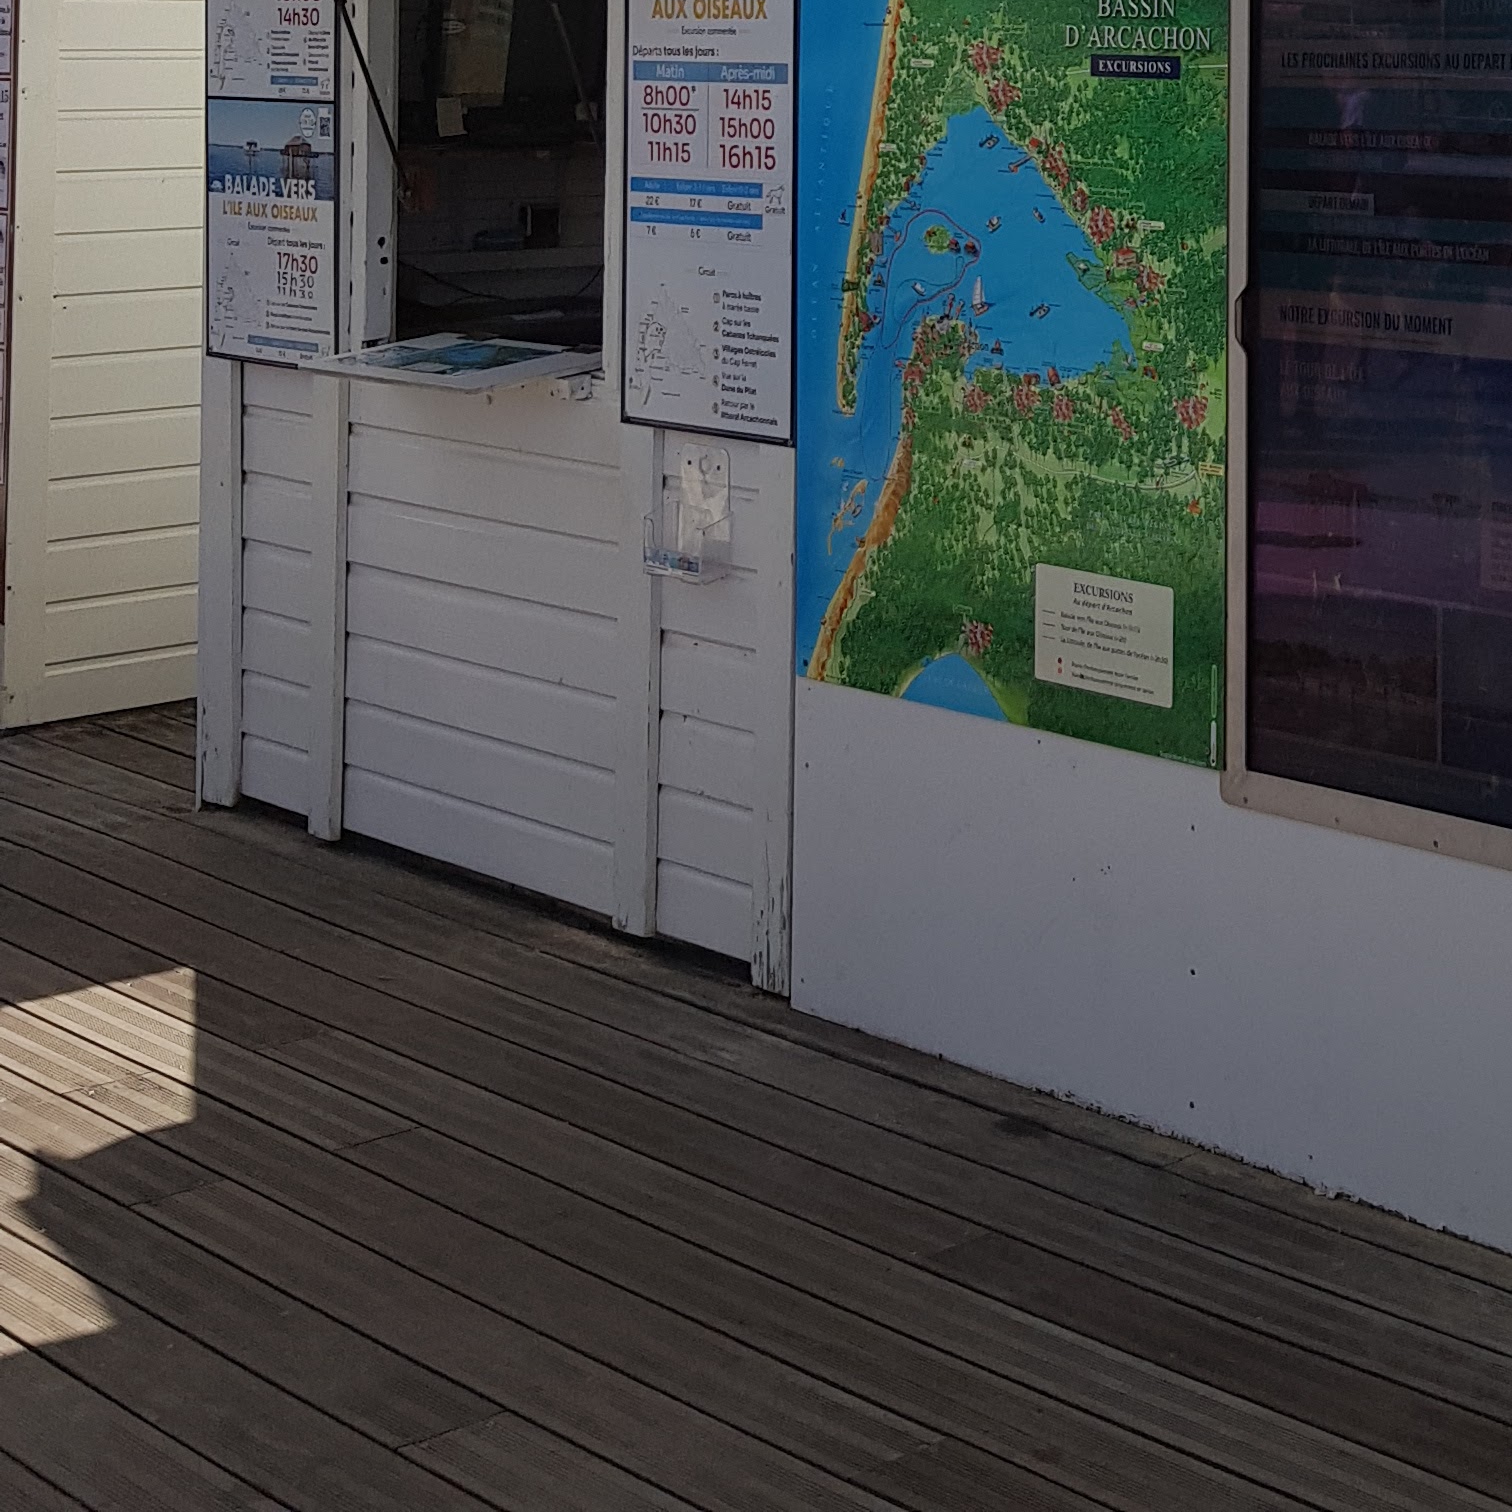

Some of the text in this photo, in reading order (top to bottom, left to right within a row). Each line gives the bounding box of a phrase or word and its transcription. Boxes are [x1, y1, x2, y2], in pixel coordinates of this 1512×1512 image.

[277, 7, 320, 26] 14h30
[1064, 24, 1212, 51] D'ARCACHON
[1098, 58, 1172, 74] EXCURSIONS
[1280, 50, 1299, 69] LES
[1301, 49, 1370, 70] PROCHAINES
[1371, 50, 1442, 71] EXCURSIONS
[1444, 52, 1461, 70] AU
[656, 62, 776, 83] Matin Après-midi
[723, 88, 773, 111] 14h15
[642, 112, 697, 136] 10h30
[719, 116, 776, 140] 15h00
[647, 140, 692, 164] 11h15
[719, 143, 778, 171] 16h15
[224, 174, 317, 201] BALADE VERS
[246, 201, 268, 219] AUX
[271, 203, 319, 223] OISEAUX
[277, 251, 319, 275] 17h30
[1278, 305, 1454, 336] NOTRE EXCURSION DU MOMENT
[1072, 581, 1134, 604] EXCURSIONS
